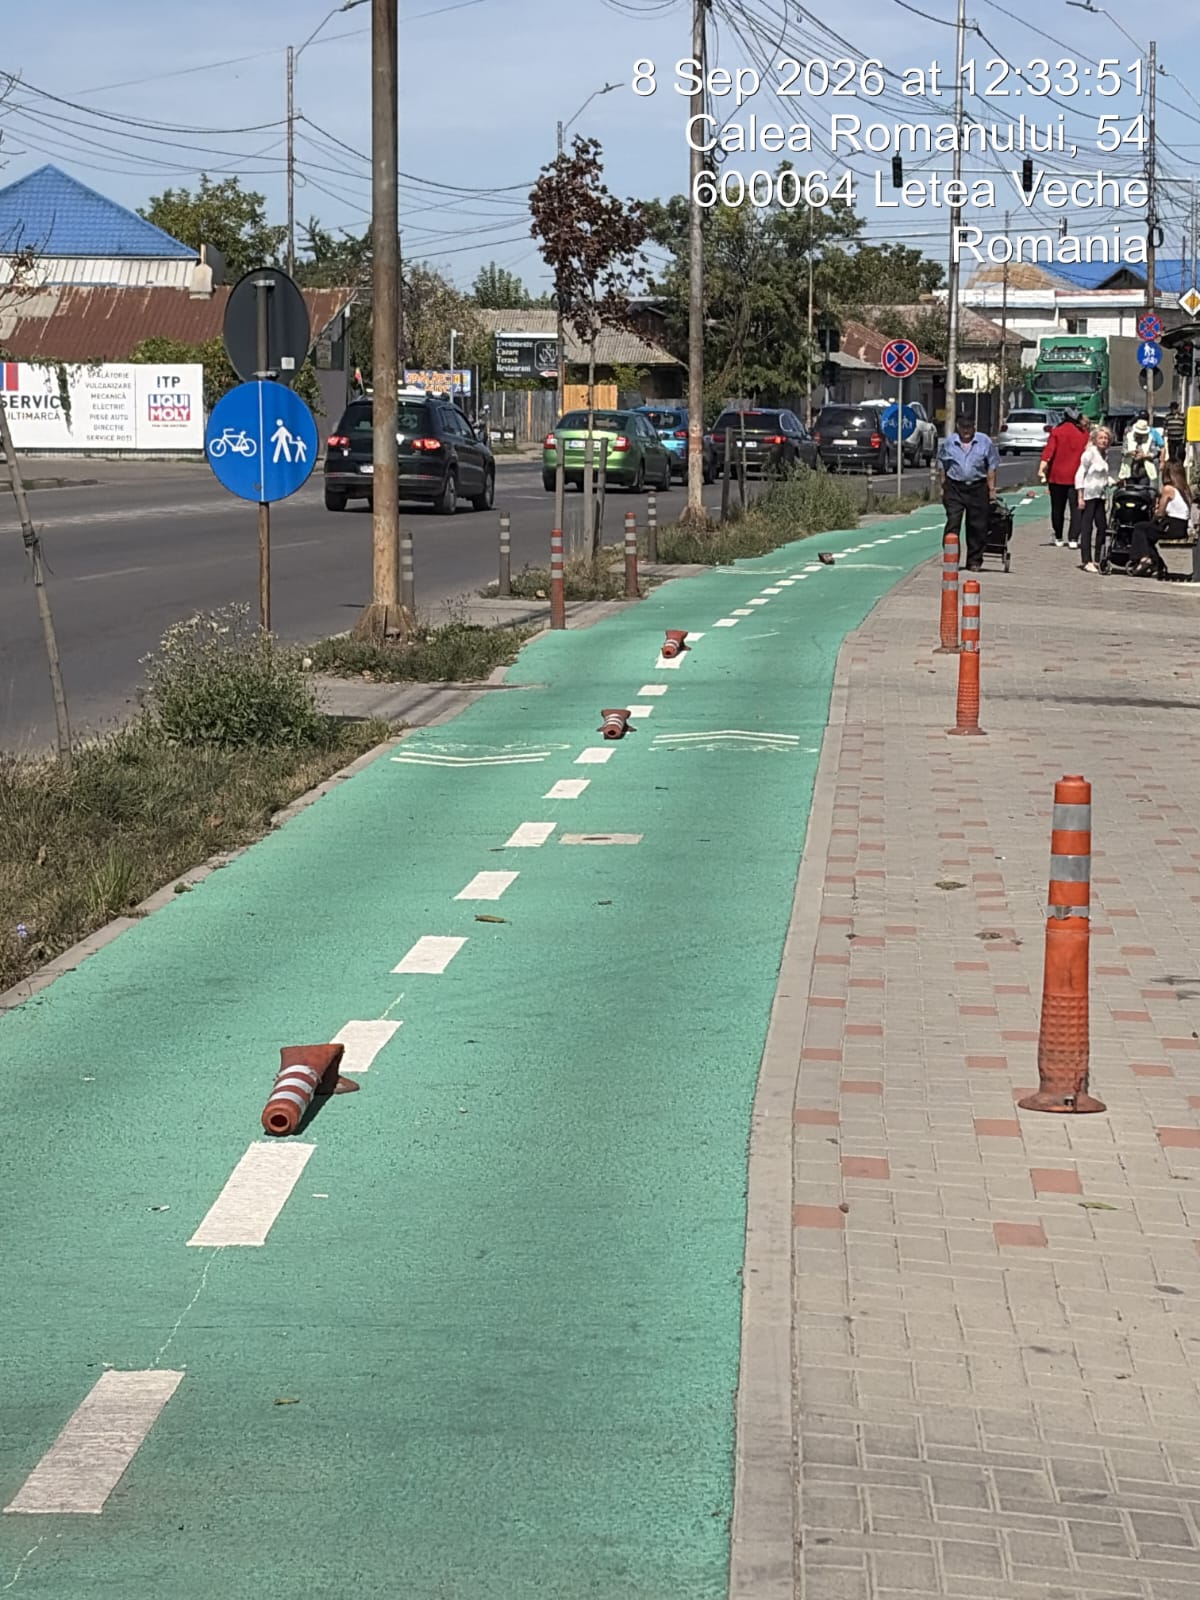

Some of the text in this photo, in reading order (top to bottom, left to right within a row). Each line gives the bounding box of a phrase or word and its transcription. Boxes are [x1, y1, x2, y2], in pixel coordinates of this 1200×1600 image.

[157, 375, 181, 389] ITP
[0, 395, 62, 409] SERVIC
[149, 395, 189, 408] LIQUI
[150, 408, 190, 421] MOLY
